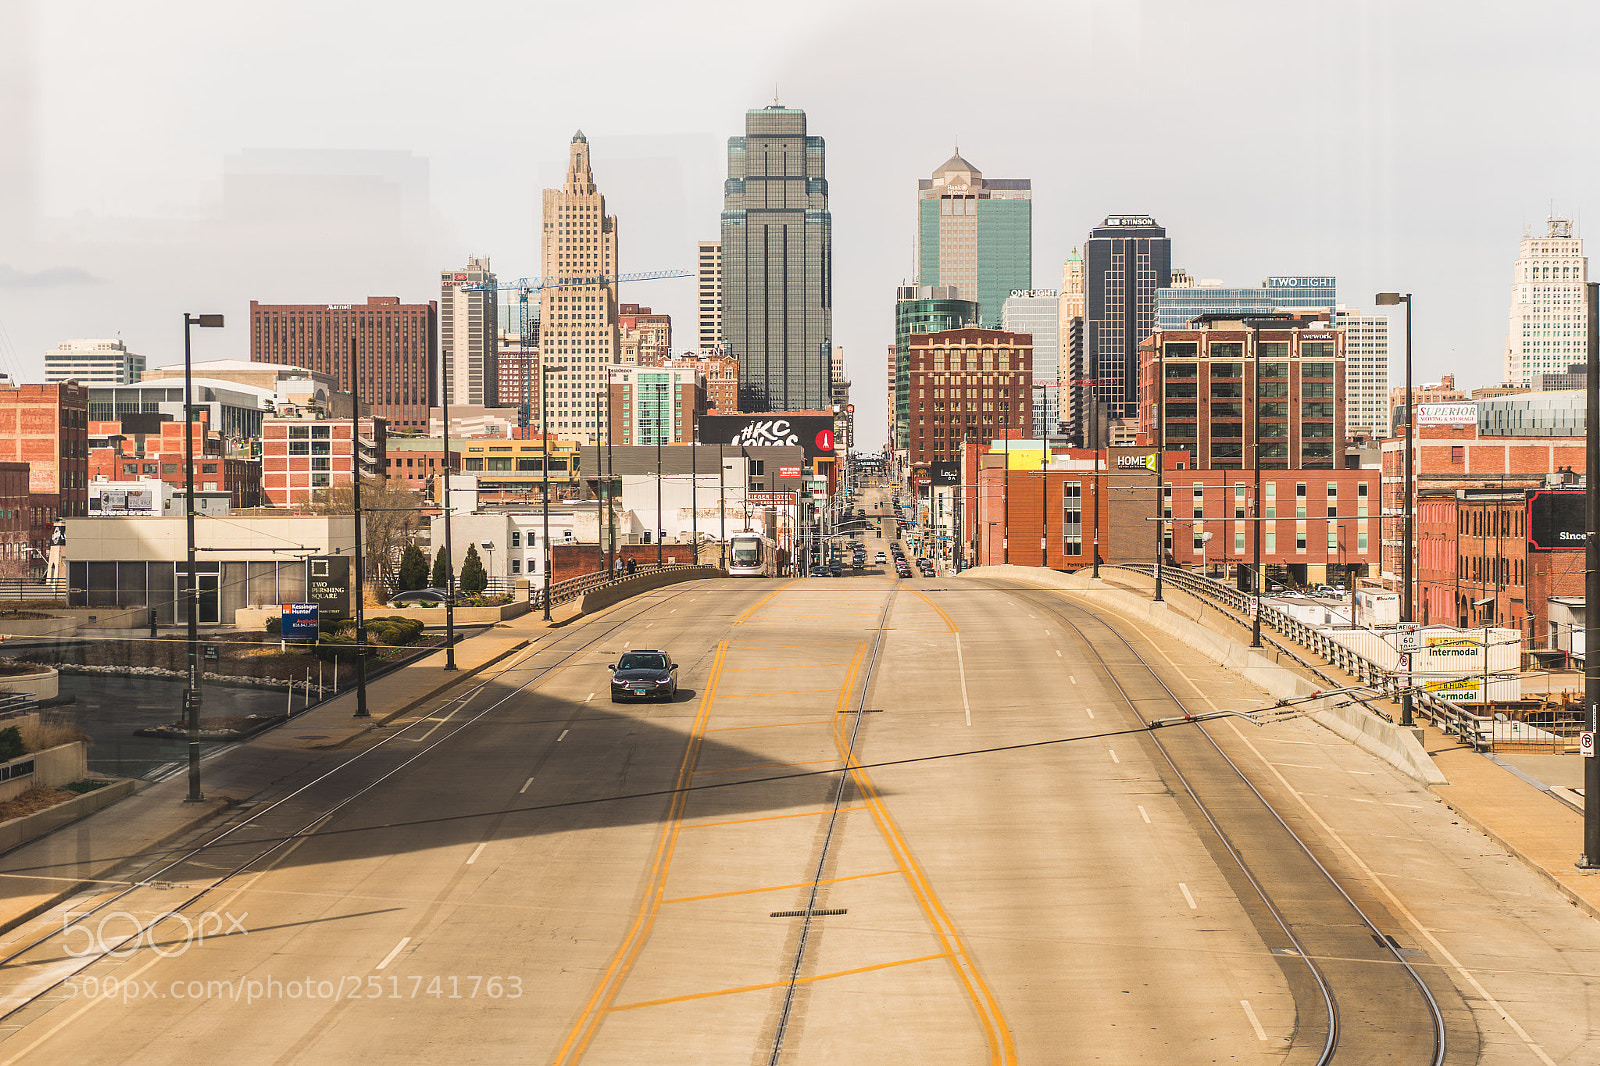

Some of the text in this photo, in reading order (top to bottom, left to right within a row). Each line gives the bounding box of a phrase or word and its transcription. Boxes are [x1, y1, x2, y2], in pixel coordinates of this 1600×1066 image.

[1270, 277, 1334, 287] TWO LIGHT
[1010, 289, 1056, 297] ONE LIGHT
[327, 302, 352, 310] Marriott
[1303, 332, 1332, 340] wework
[1419, 407, 1476, 416] SUPERIOR
[1559, 531, 1587, 540] Since
[1429, 648, 1478, 656] Intermodal
